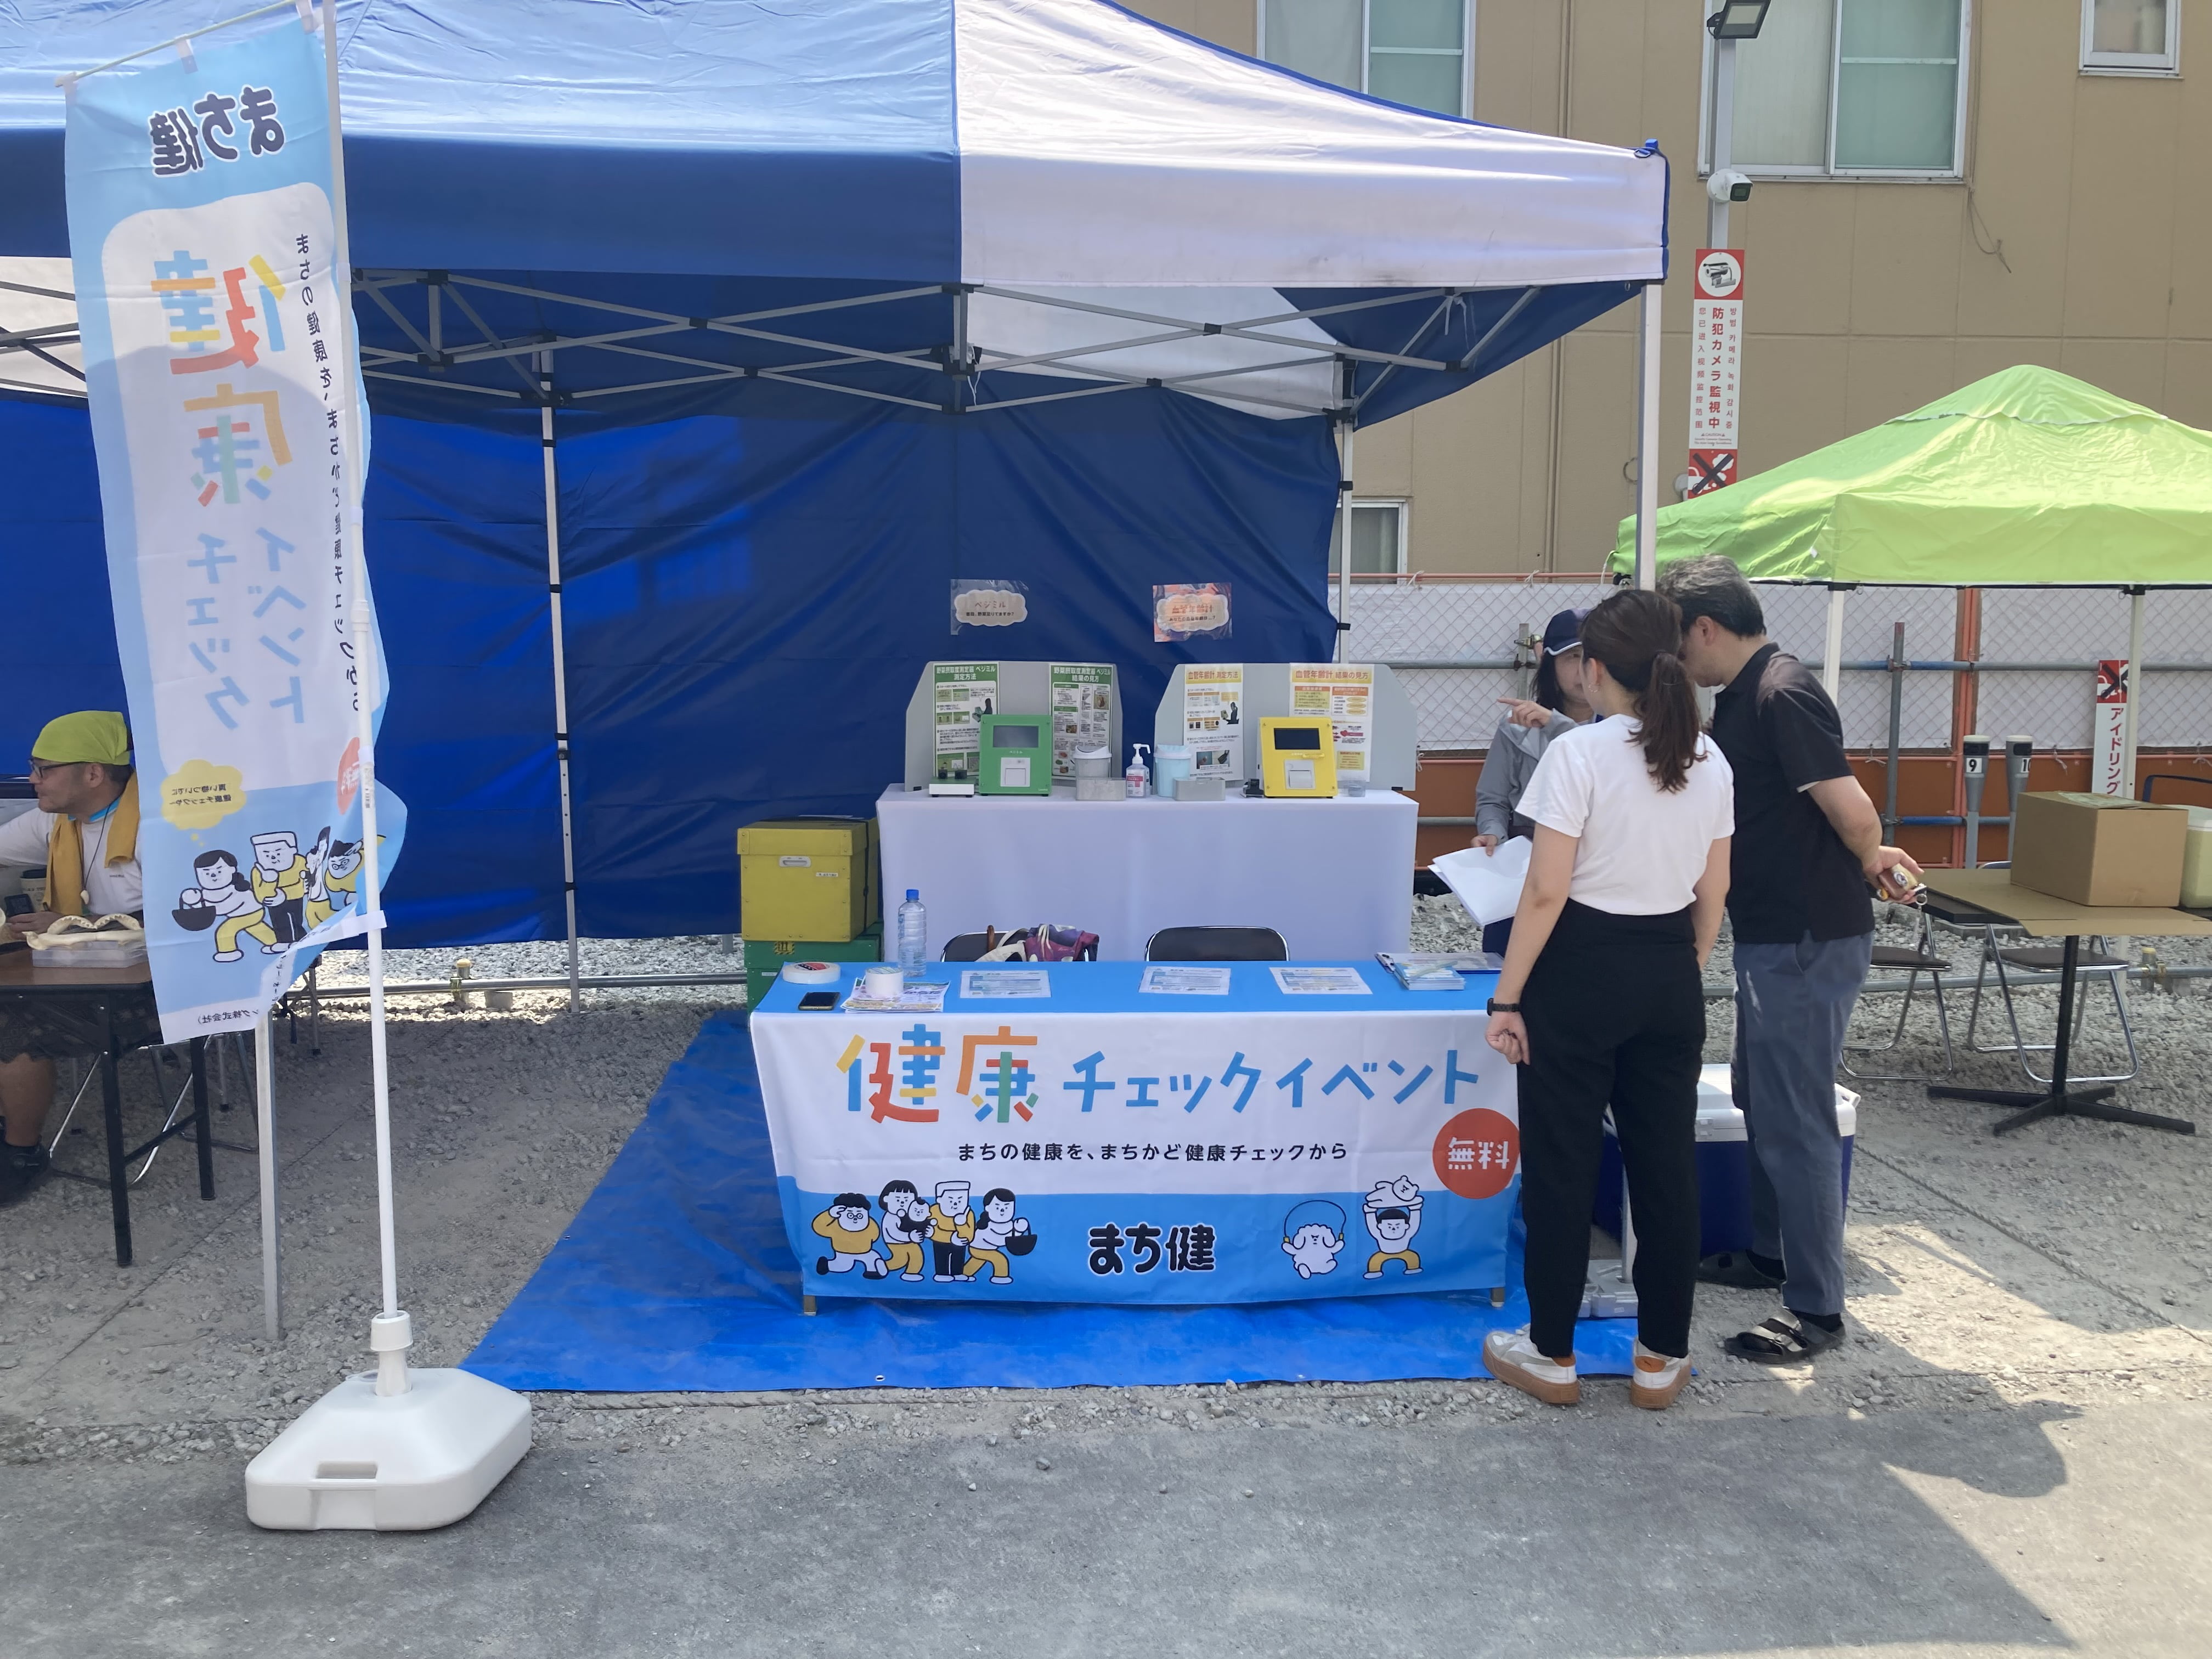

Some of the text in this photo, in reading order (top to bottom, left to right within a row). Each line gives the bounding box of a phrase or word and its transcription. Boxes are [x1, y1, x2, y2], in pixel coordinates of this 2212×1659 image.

[1729, 307, 1737, 327] 방범
[1695, 307, 1707, 428] 您已进入视频监控范围
[1708, 307, 1724, 429] 防犯カメラ監視中
[1727, 372, 1735, 391] 녹화
[974, 600, 1006, 609] ベジミル
[1172, 603, 1213, 614] 血管年齢計
[1188, 671, 1239, 680] 血管年齢計 測定方法
[1295, 670, 1333, 679] 血管年齢計
[2106, 707, 2124, 795] アイドリング
[1968, 759, 1977, 772] 9
[958, 1142, 1347, 1163] まちの健康を、まちかど健康チェックから
[1447, 1136, 1510, 1171] 無料
[1088, 1223, 1216, 1277] まち健
